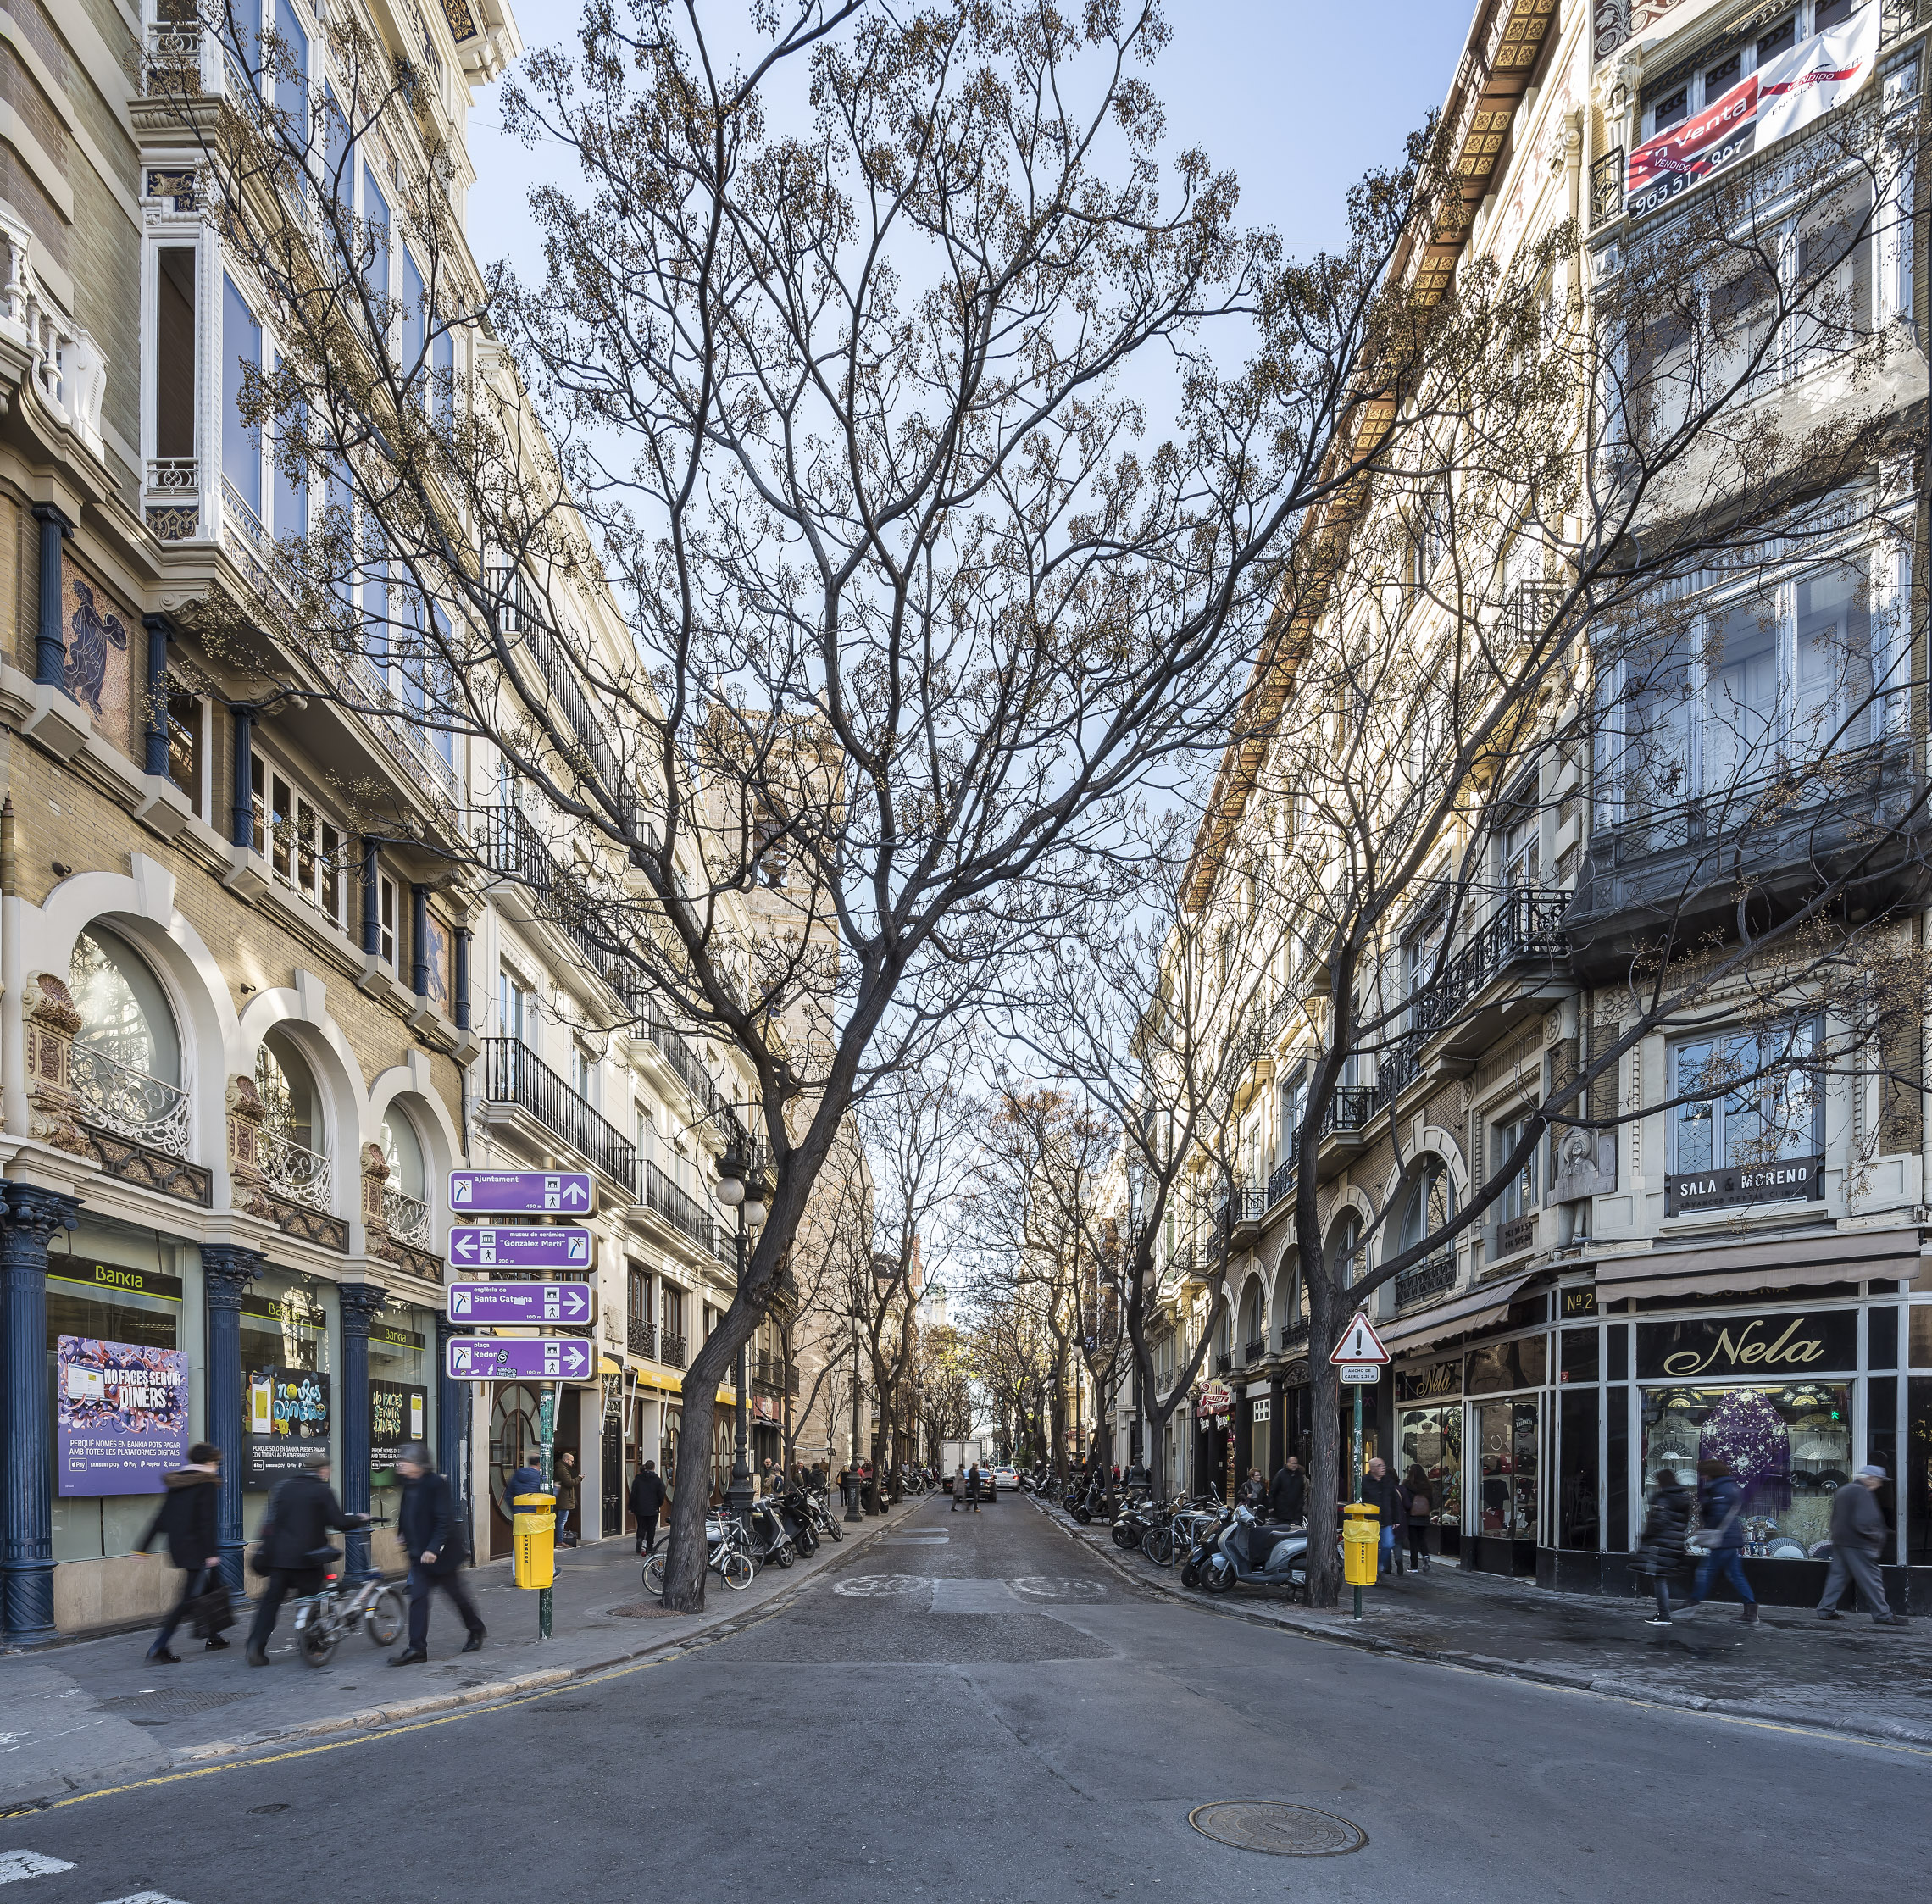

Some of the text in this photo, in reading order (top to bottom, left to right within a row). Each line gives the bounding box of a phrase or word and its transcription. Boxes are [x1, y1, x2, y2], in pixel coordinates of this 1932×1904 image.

[1787, 73, 1835, 92] VENDIDO
[1674, 97, 1747, 147] Venta
[1654, 158, 1691, 172] VENDIDO
[1635, 184, 1668, 215] 963
[1680, 1168, 1807, 1196] SALA & MORENO
[1679, 1197, 1724, 1209] ADVANCED
[1730, 1193, 1764, 1202] DENTAL
[95, 1265, 143, 1288] Bankia
[1585, 1293, 1593, 1309] 2
[385, 1328, 407, 1343] Bankia
[1663, 1318, 1824, 1376] Nela
[104, 1368, 181, 1387] NO FACES SERVIR
[1416, 1368, 1451, 1397] Nela
[119, 1386, 167, 1408] DINERS
[373, 1391, 403, 1409] NO FACES
[374, 1406, 401, 1419] SERVIR
[373, 1418, 401, 1435] DINERS
[69, 1438, 94, 1448] PERQUÈ
[95, 1439, 117, 1448] NOMÉS
